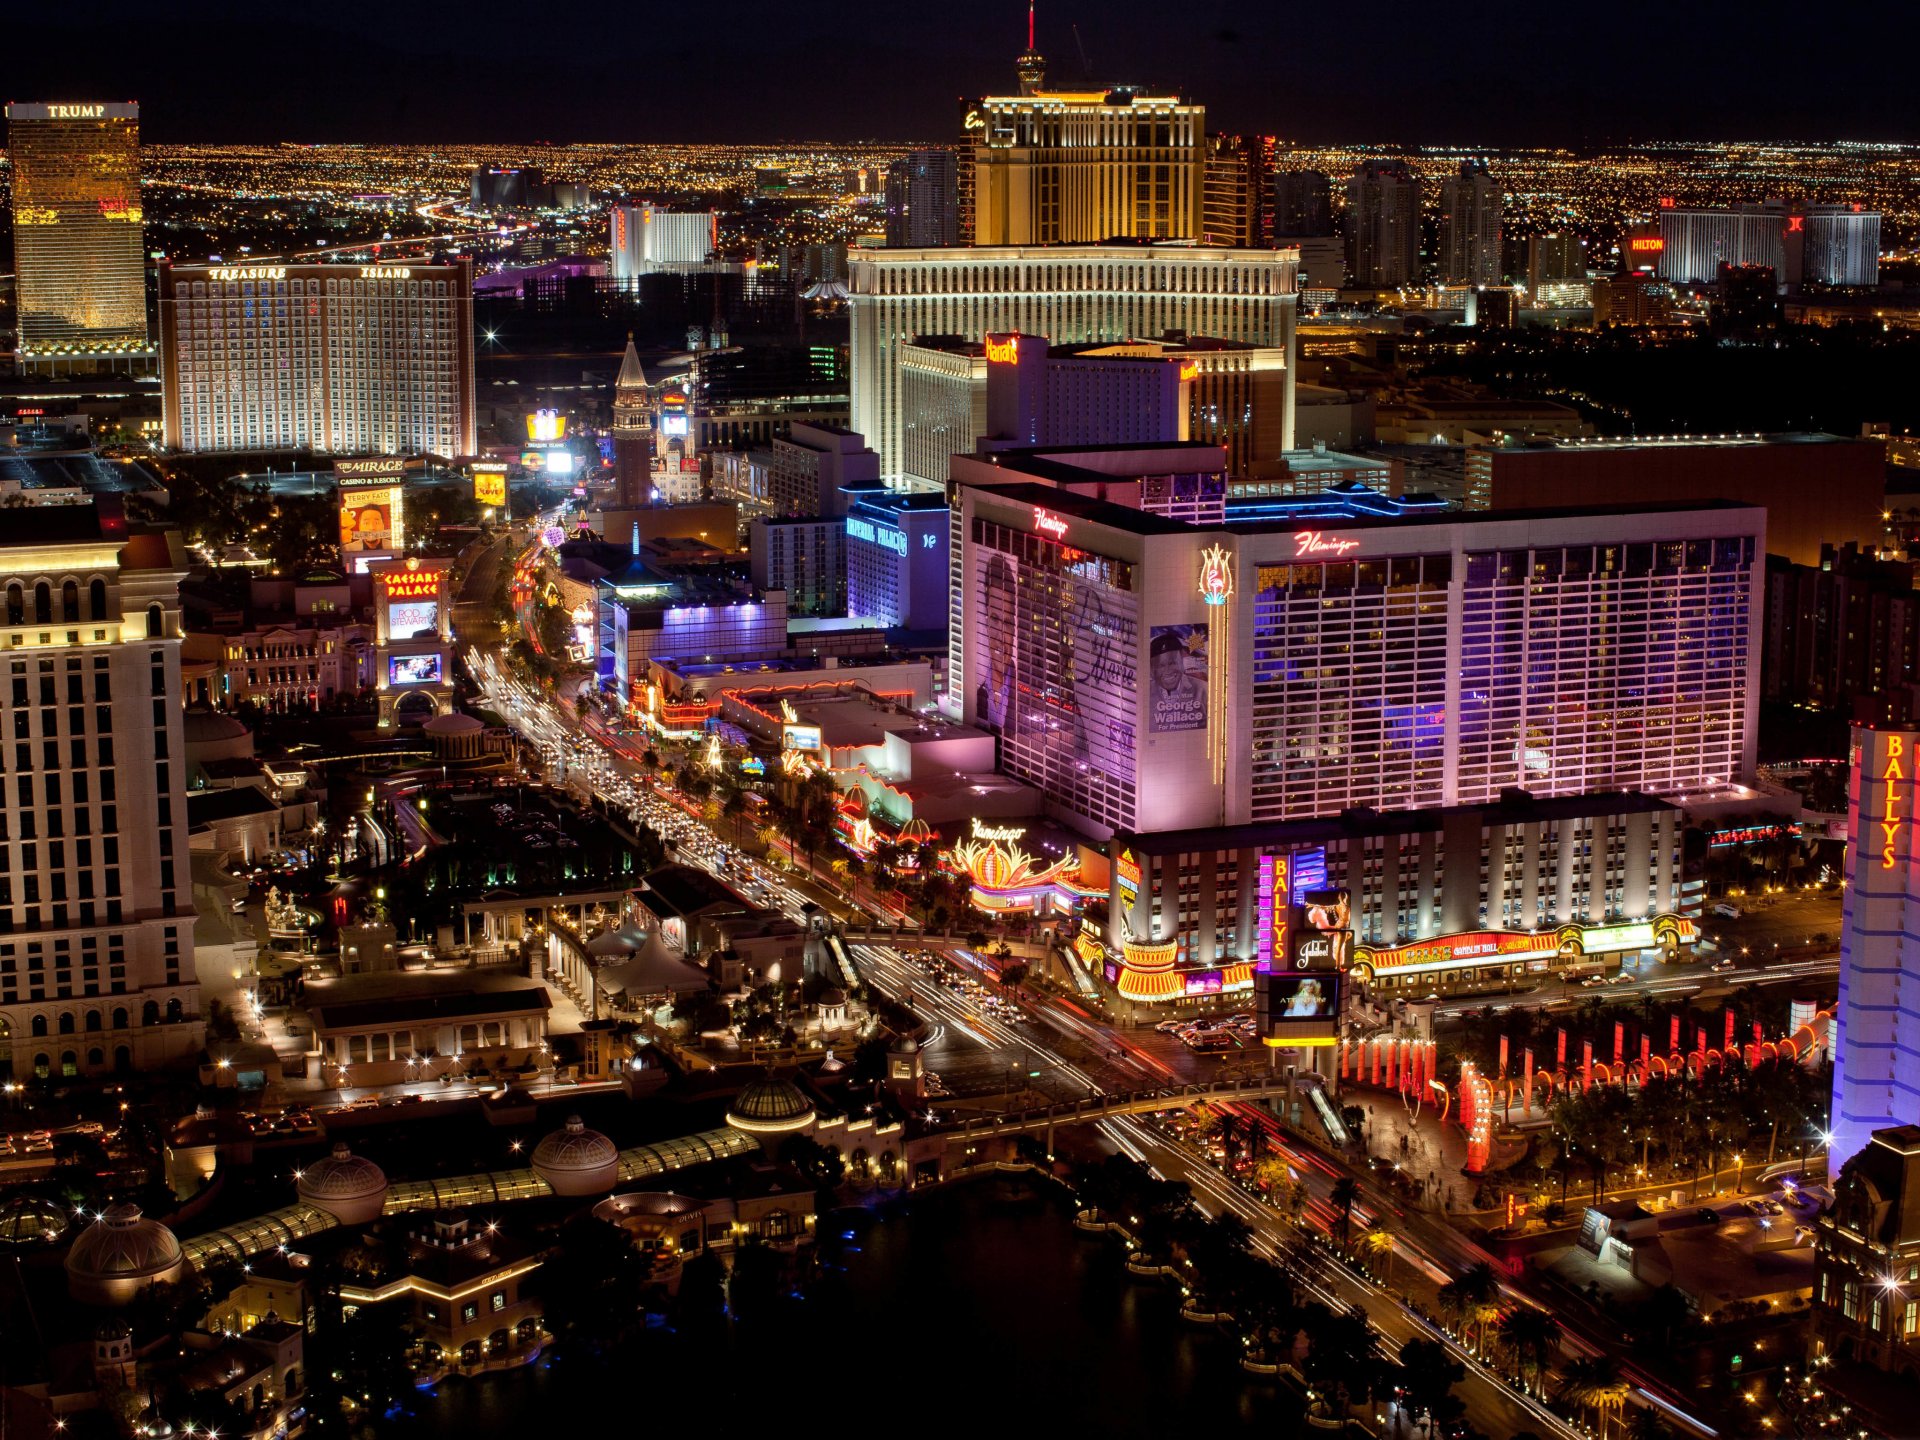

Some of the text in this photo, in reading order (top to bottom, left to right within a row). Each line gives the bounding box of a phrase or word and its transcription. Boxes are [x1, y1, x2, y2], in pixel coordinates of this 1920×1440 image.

[48, 105, 105, 118] TRUMP
[1632, 239, 1663, 250] HILTON
[209, 267, 411, 281] TREASURE ISLAND
[351, 460, 403, 473] MIRAGE
[339, 478, 366, 486] CASINO
[373, 476, 401, 484] RESORT
[347, 494, 371, 502] TERRY
[1033, 506, 1069, 540] Flamingo
[846, 517, 876, 543] IMPERIAL
[877, 527, 901, 551] PALAC
[1294, 531, 1359, 557] Flamingo
[385, 572, 440, 584] CAESARS
[388, 584, 438, 597] PALACE
[398, 609, 421, 618] ROD
[391, 617, 429, 626] STEWART
[1156, 699, 1201, 712] George
[1153, 711, 1203, 724] Wallace
[1169, 721, 1199, 730] President
[1881, 735, 1904, 870] BALLYS
[972, 817, 1026, 847] Flamingo
[1273, 860, 1288, 959] BALLYS
[1482, 943, 1498, 953] HALL
